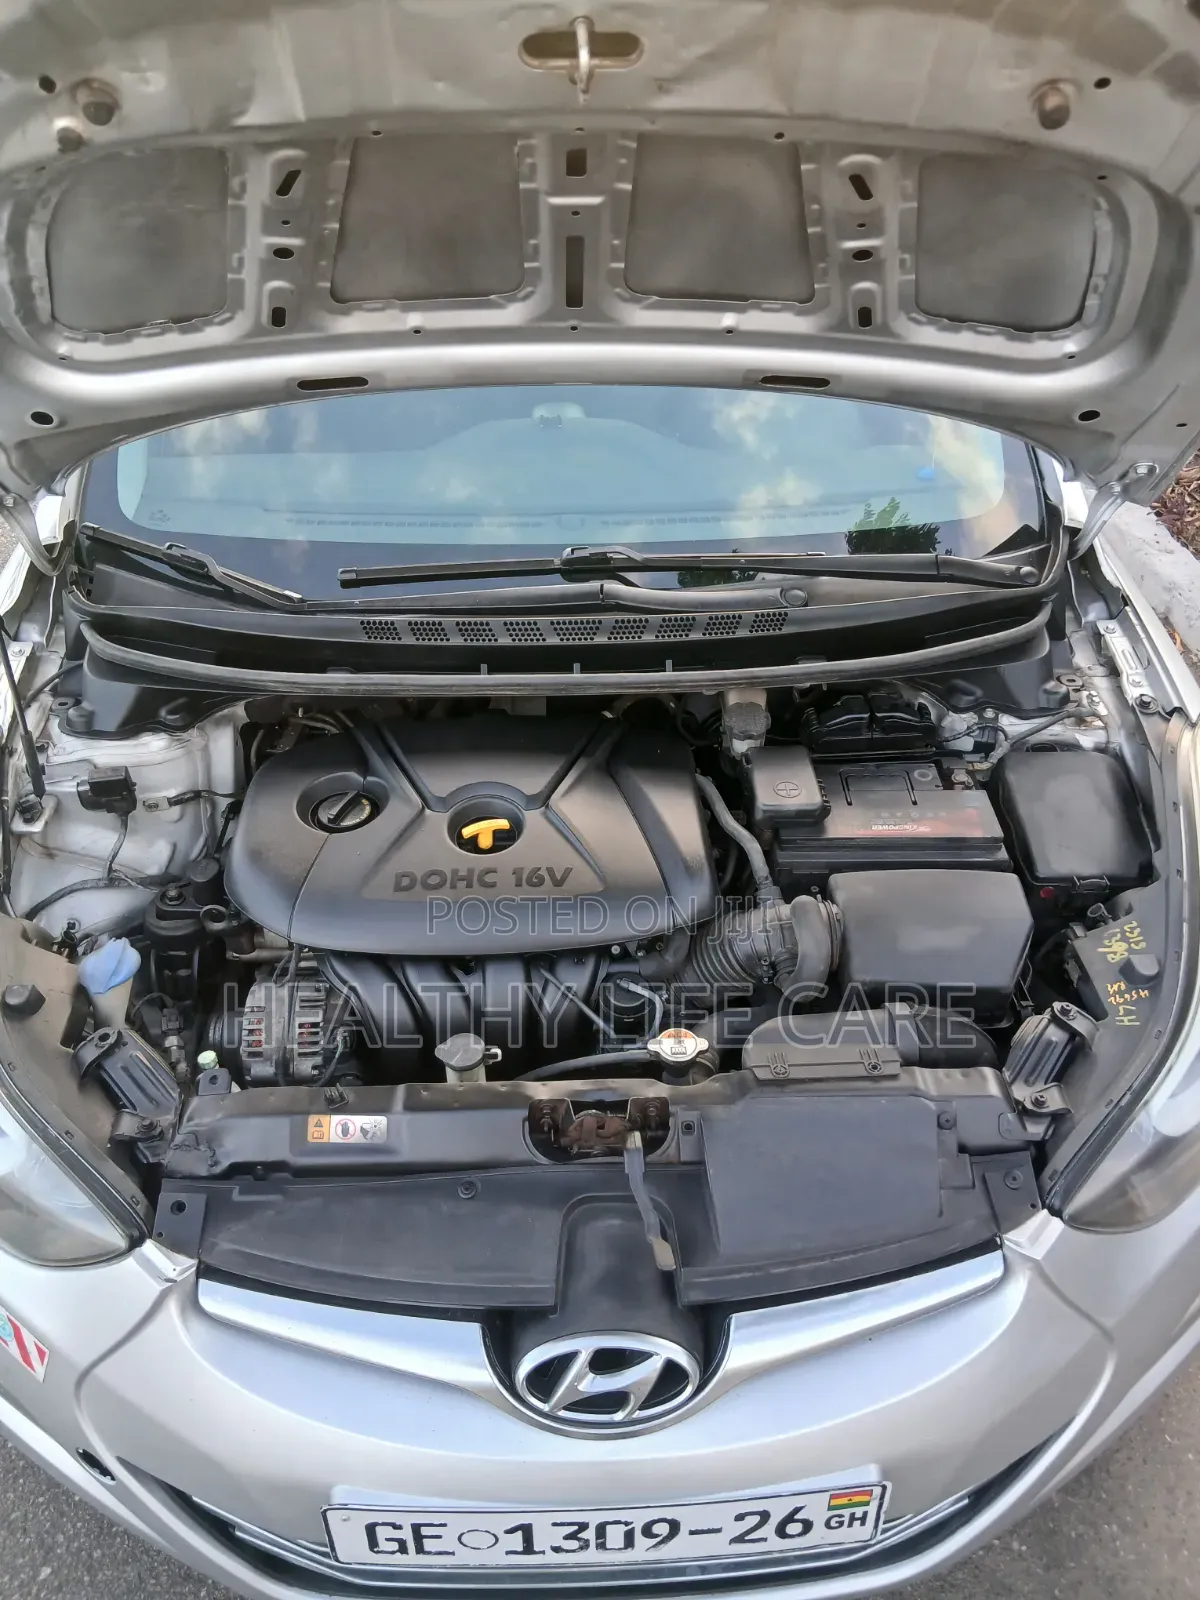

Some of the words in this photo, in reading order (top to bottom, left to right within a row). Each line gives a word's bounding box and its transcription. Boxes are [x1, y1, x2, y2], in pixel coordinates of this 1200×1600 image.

[392, 867, 498, 893] DOHC
[511, 866, 573, 888] 16V
[364, 1521, 456, 1556] GE
[503, 1504, 814, 1555] 1309-26
[824, 1511, 869, 1531] GH
